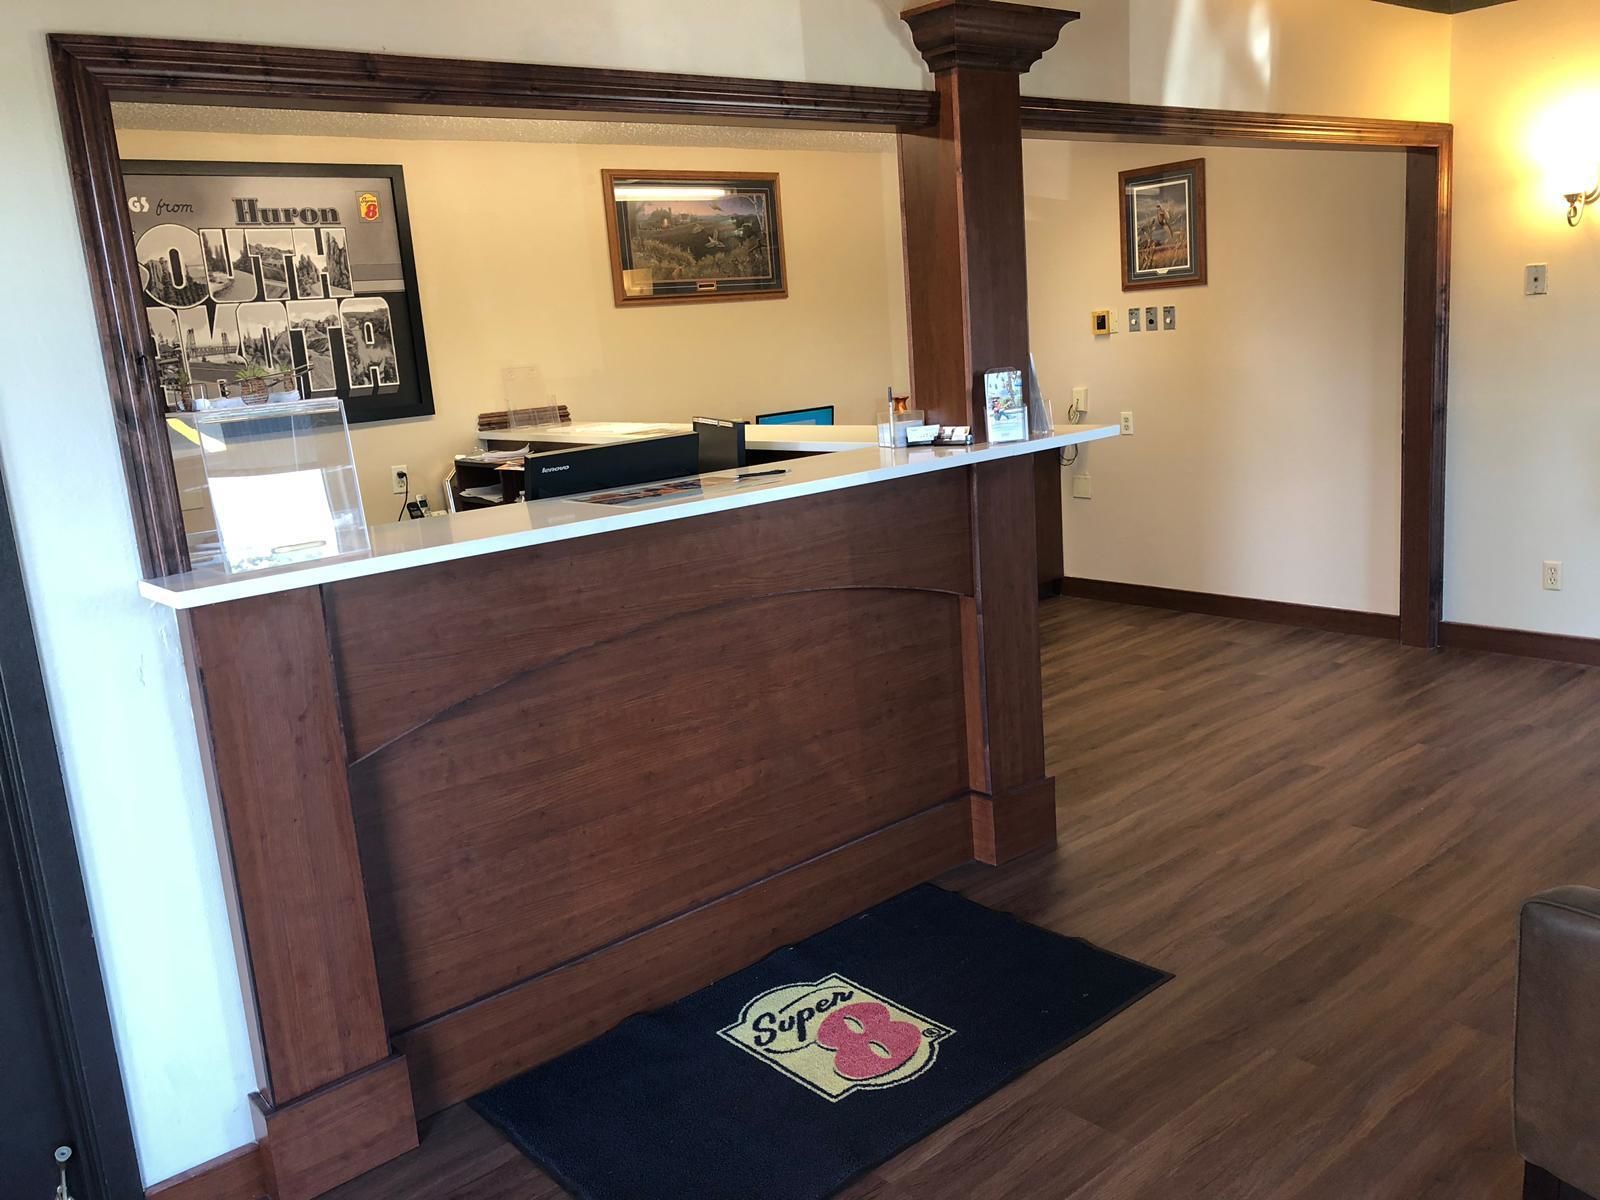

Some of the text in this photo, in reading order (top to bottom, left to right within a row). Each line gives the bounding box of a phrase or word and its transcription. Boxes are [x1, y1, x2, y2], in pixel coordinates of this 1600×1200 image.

[155, 198, 194, 217] from
[232, 197, 341, 226] Huron
[365, 203, 378, 219] 8
[136, 223, 354, 310] OUTH
[541, 465, 570, 473] lenovo
[752, 990, 855, 1047] Super
[817, 1002, 922, 1080] 8
